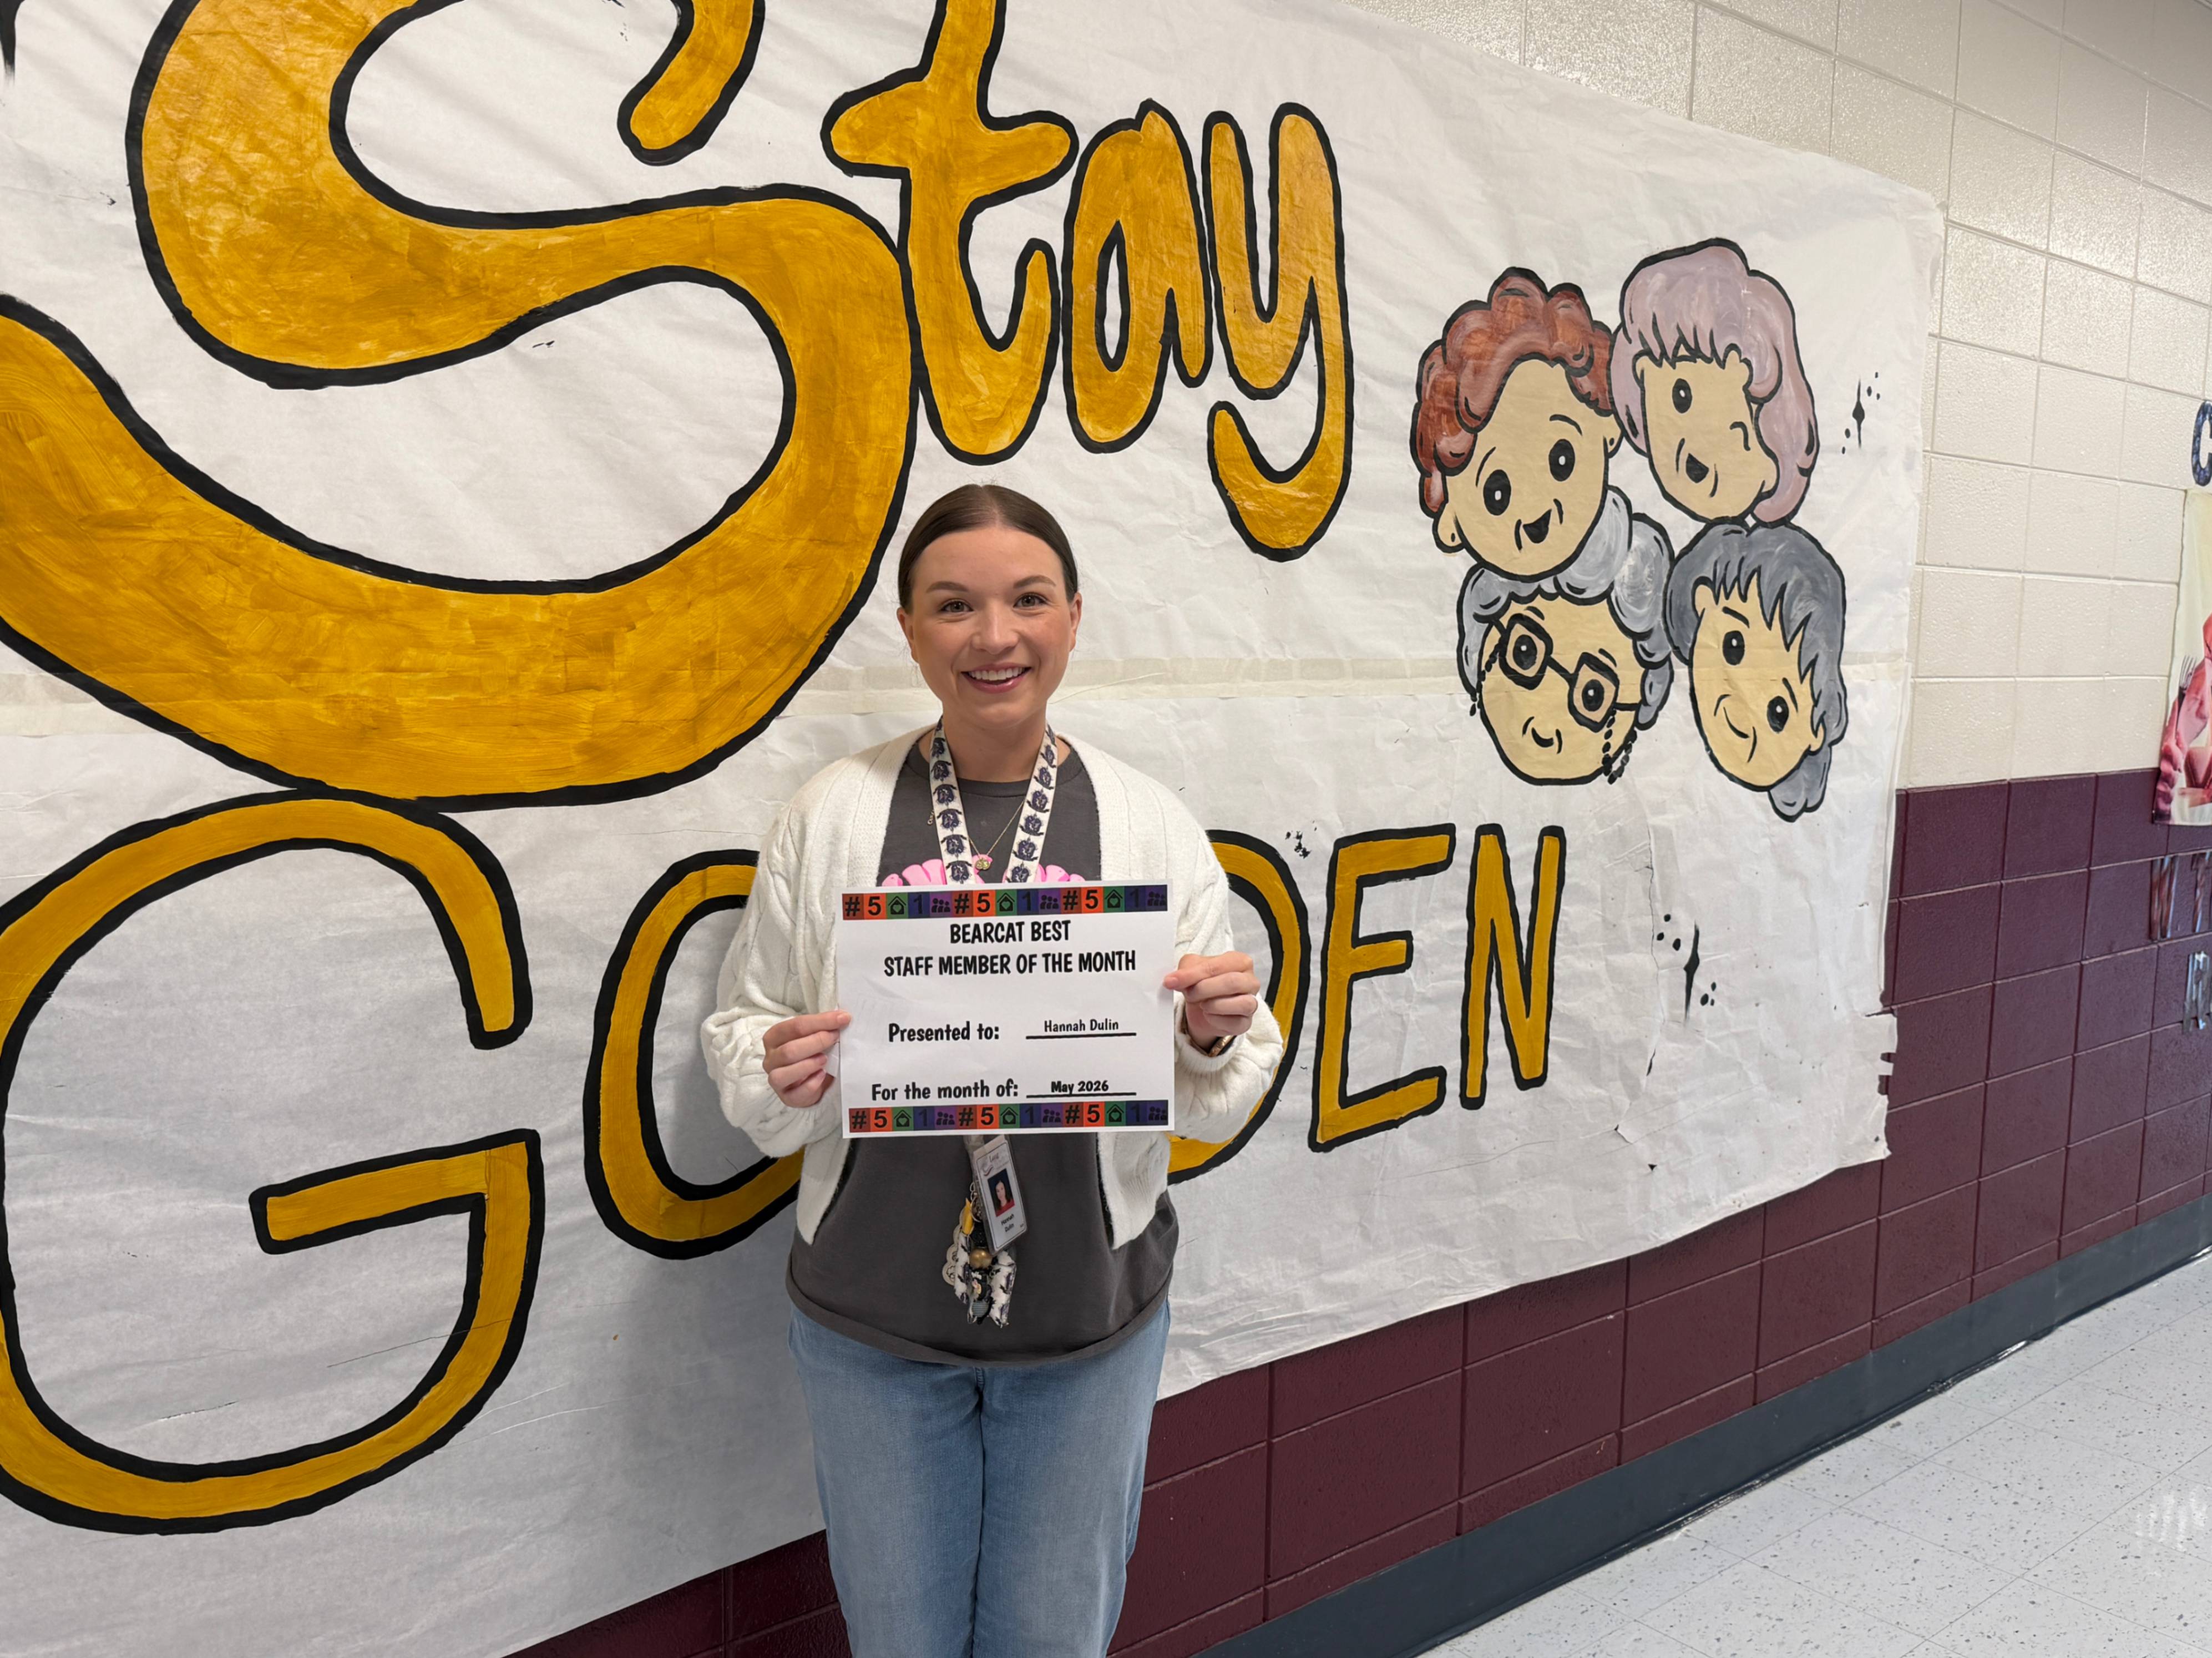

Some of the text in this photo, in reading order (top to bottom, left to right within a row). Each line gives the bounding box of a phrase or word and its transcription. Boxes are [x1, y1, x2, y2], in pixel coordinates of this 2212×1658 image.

[0, 0, 1353, 811] Stay
[950, 920, 1071, 943] BEARCAT BEST
[884, 950, 1136, 977] STAFF MEMBER OF THE MONTH
[889, 1018, 1118, 1042] Presented to: Hannah Dulin
[872, 1078, 1109, 1101] For the month of: May 2026
[0, 788, 1566, 1535] GODEN
